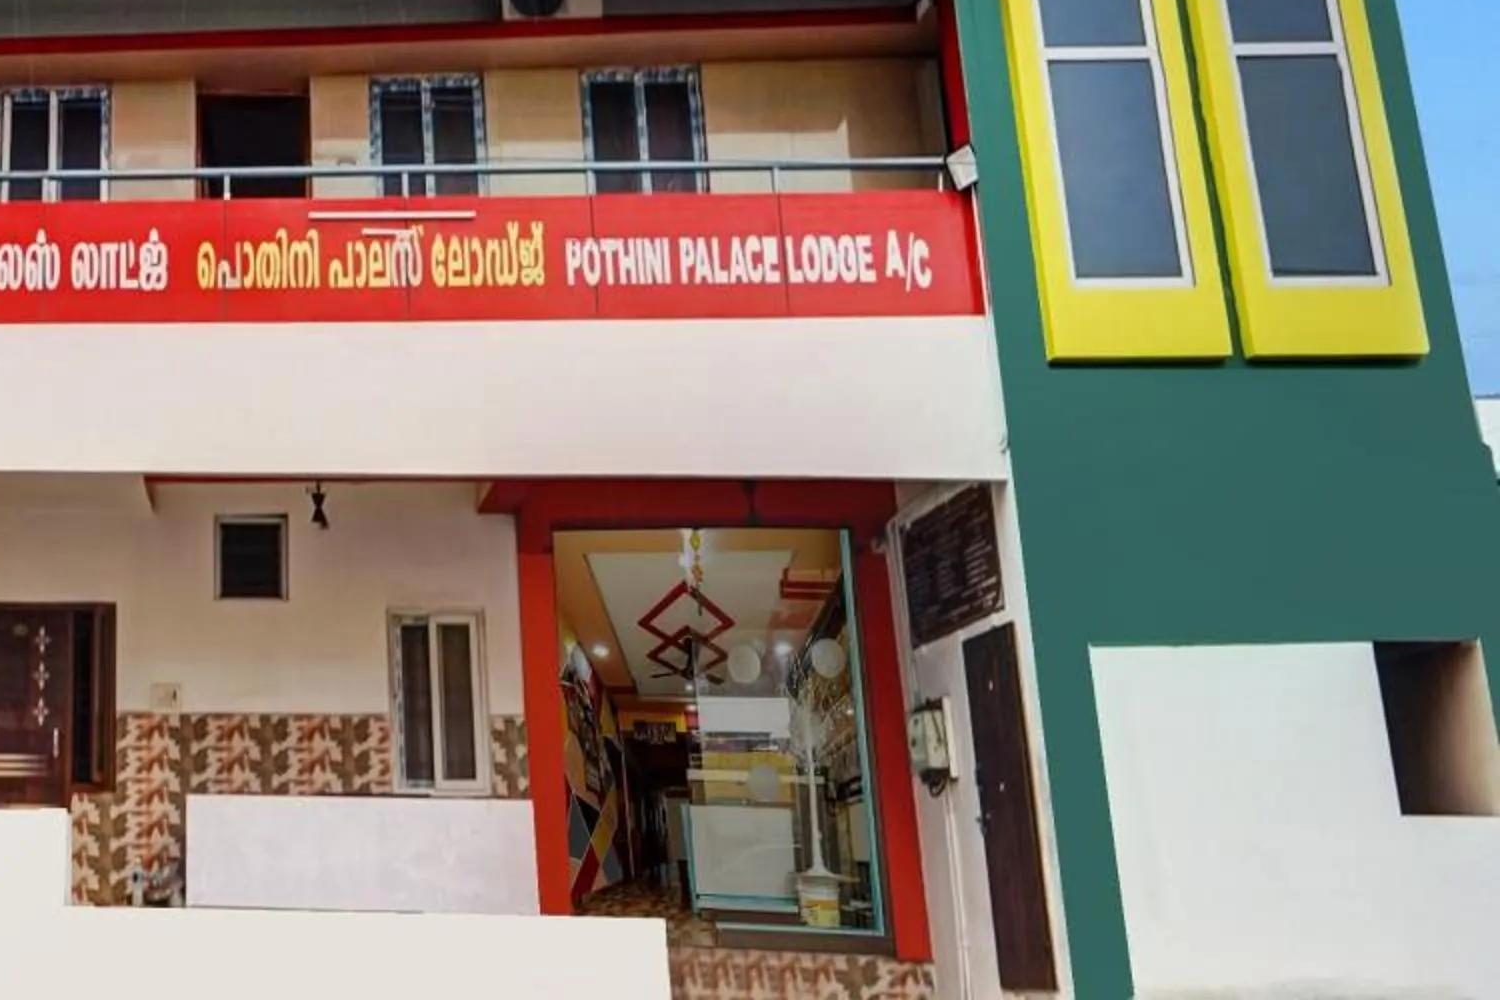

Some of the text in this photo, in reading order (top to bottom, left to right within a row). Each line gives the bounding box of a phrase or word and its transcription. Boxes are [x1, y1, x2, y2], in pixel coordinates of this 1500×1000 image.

[71, 228, 169, 291] லாட்ஜ்
[565, 230, 932, 292] POTHINI PALACE LODGE A/C
